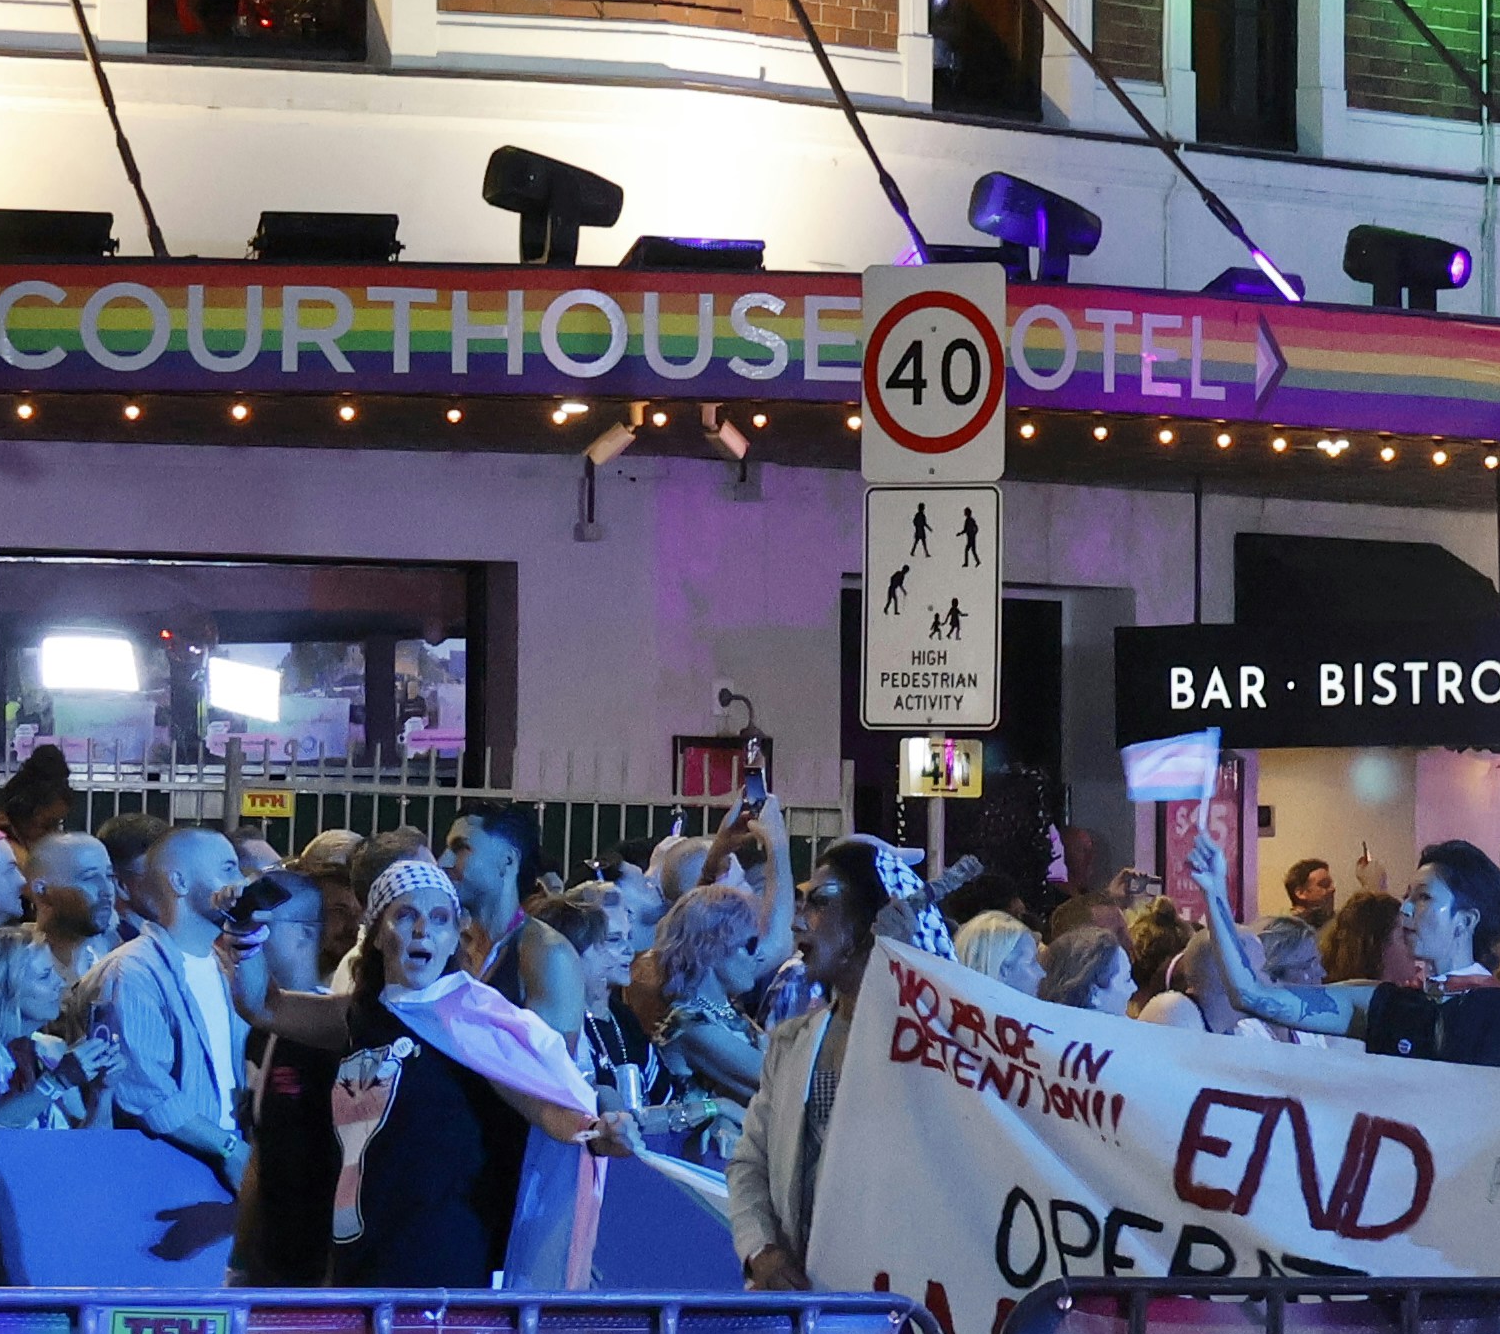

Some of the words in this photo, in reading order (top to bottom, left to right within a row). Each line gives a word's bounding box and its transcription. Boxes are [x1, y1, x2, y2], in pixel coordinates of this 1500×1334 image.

[885, 337, 981, 407] 40
[1007, 303, 1228, 403] OTEL
[911, 648, 947, 667] HIGH
[880, 671, 978, 690] PEDESTRIAN
[893, 693, 964, 712] ACTIVITY
[1169, 665, 1268, 711] BAR
[1058, 1040, 1115, 1084] IN
[1173, 1087, 1435, 1242] END
